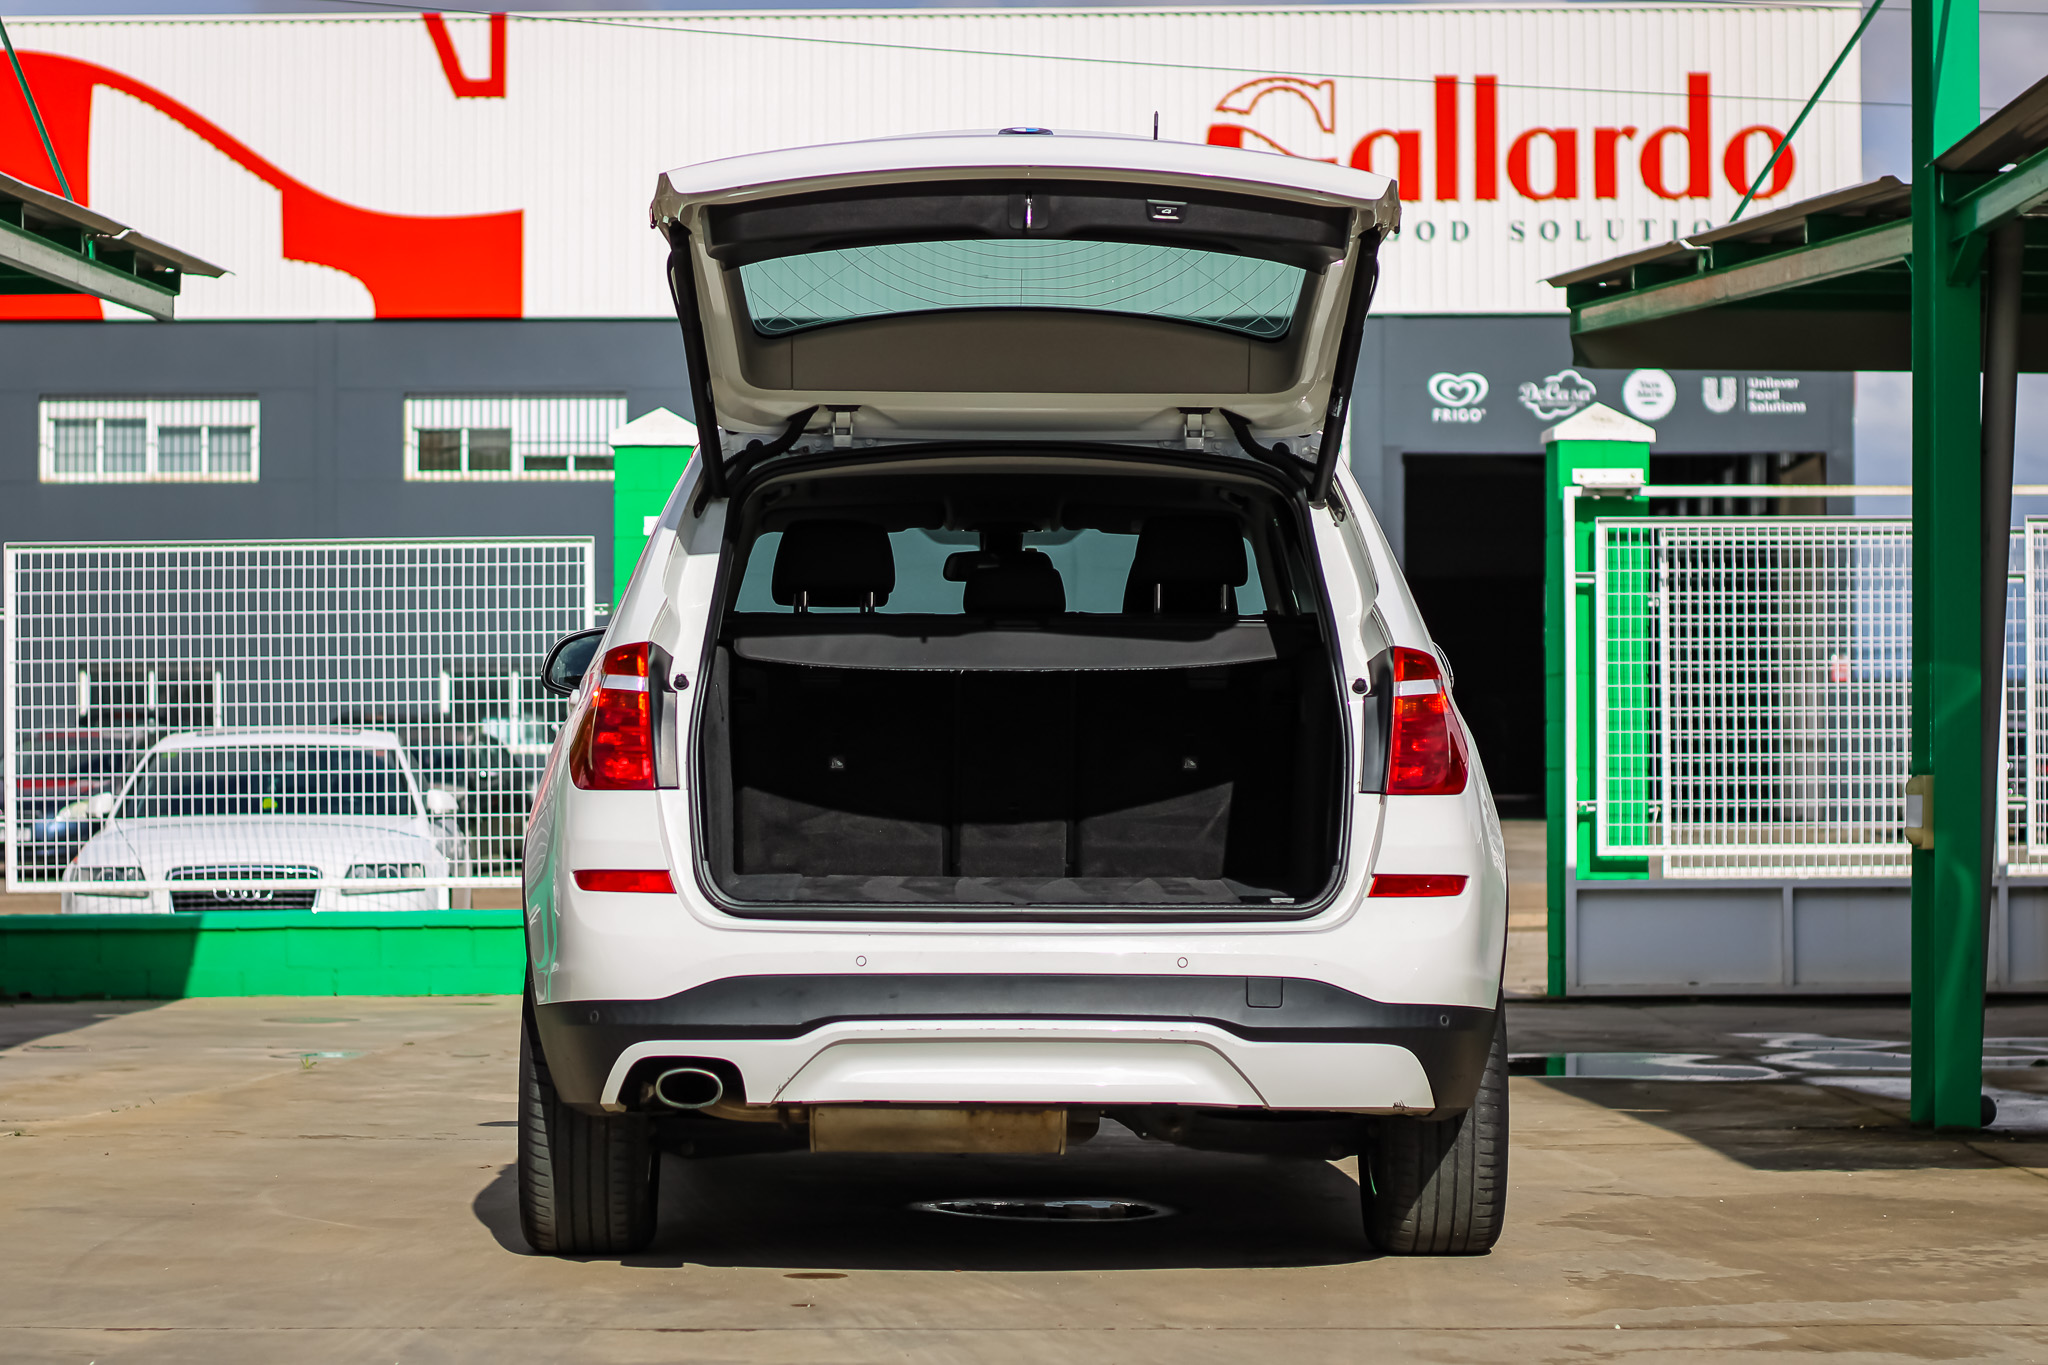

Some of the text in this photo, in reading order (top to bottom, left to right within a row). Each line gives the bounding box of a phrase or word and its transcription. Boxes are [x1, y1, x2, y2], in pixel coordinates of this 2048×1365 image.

[1748, 376, 1799, 390] Unilever
[1748, 388, 1780, 401] Food
[1748, 400, 1807, 413] Solutions
[1432, 407, 1482, 423] FRIGO
